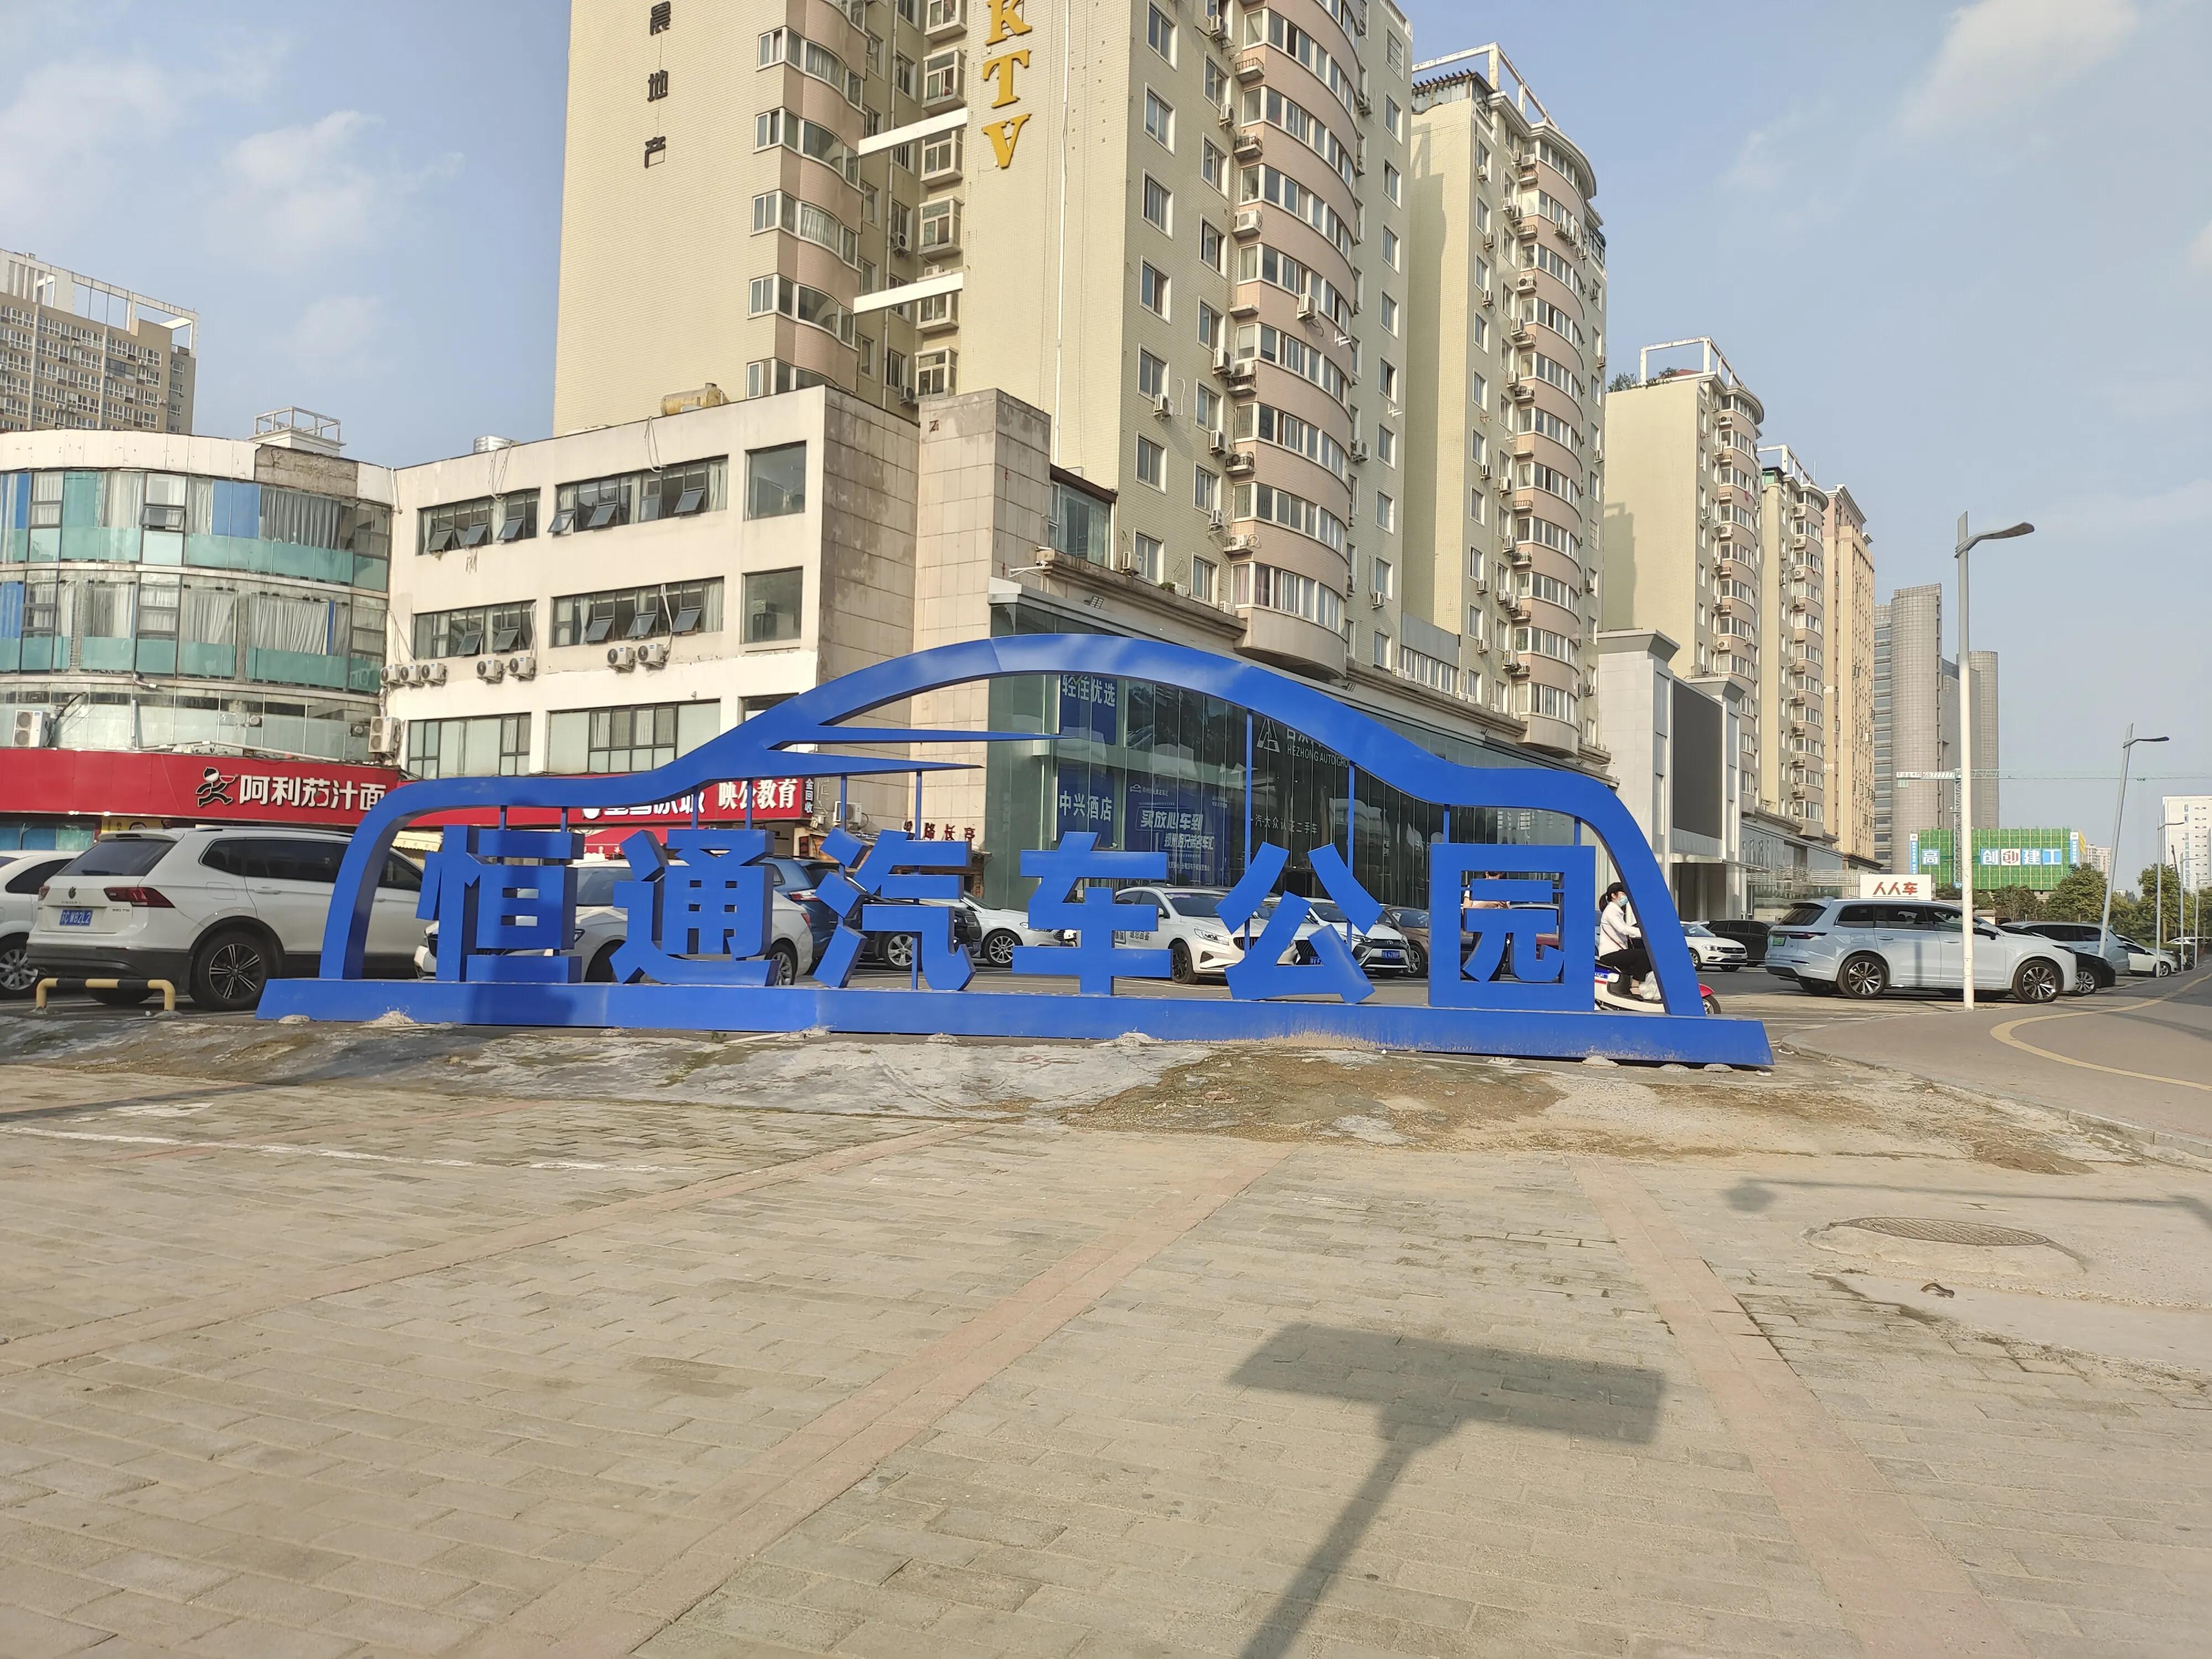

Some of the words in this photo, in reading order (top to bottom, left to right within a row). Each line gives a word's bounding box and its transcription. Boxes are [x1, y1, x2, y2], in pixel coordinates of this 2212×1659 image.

[982, 0, 1032, 169] KTV
[1062, 675, 1115, 707] 轻住优选
[1287, 744, 1318, 761] HEZHONG
[1319, 754, 1335, 765] AUTO
[1337, 756, 1349, 768] GRO
[239, 774, 387, 811] 阿利茄汁面
[1060, 790, 1112, 822] 中兴酒店
[1872, 882, 1918, 895] 人人车
[415, 825, 1595, 1011] 恒通汽车公园
